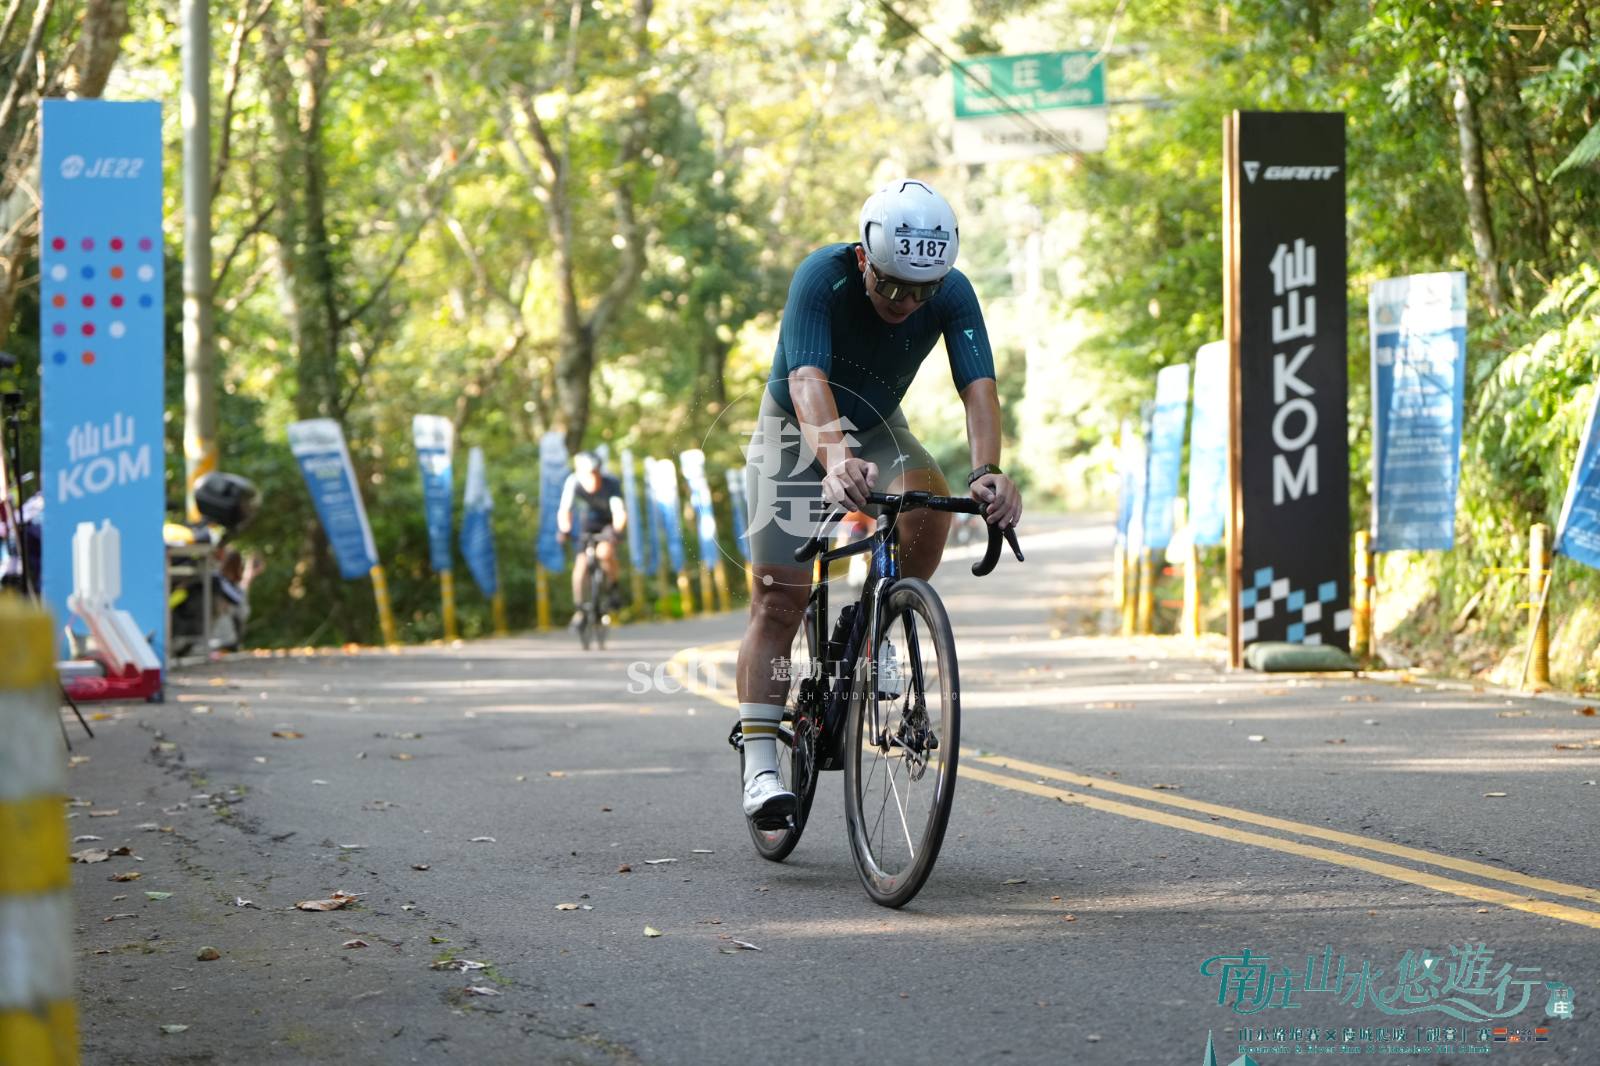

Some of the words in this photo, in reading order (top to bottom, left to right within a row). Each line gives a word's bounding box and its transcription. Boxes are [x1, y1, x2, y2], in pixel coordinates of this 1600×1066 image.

[1263, 165, 1340, 181] GIANT
[899, 238, 947, 258] 3187
[67, 411, 135, 462] 仙山
[58, 443, 150, 504] KOM
